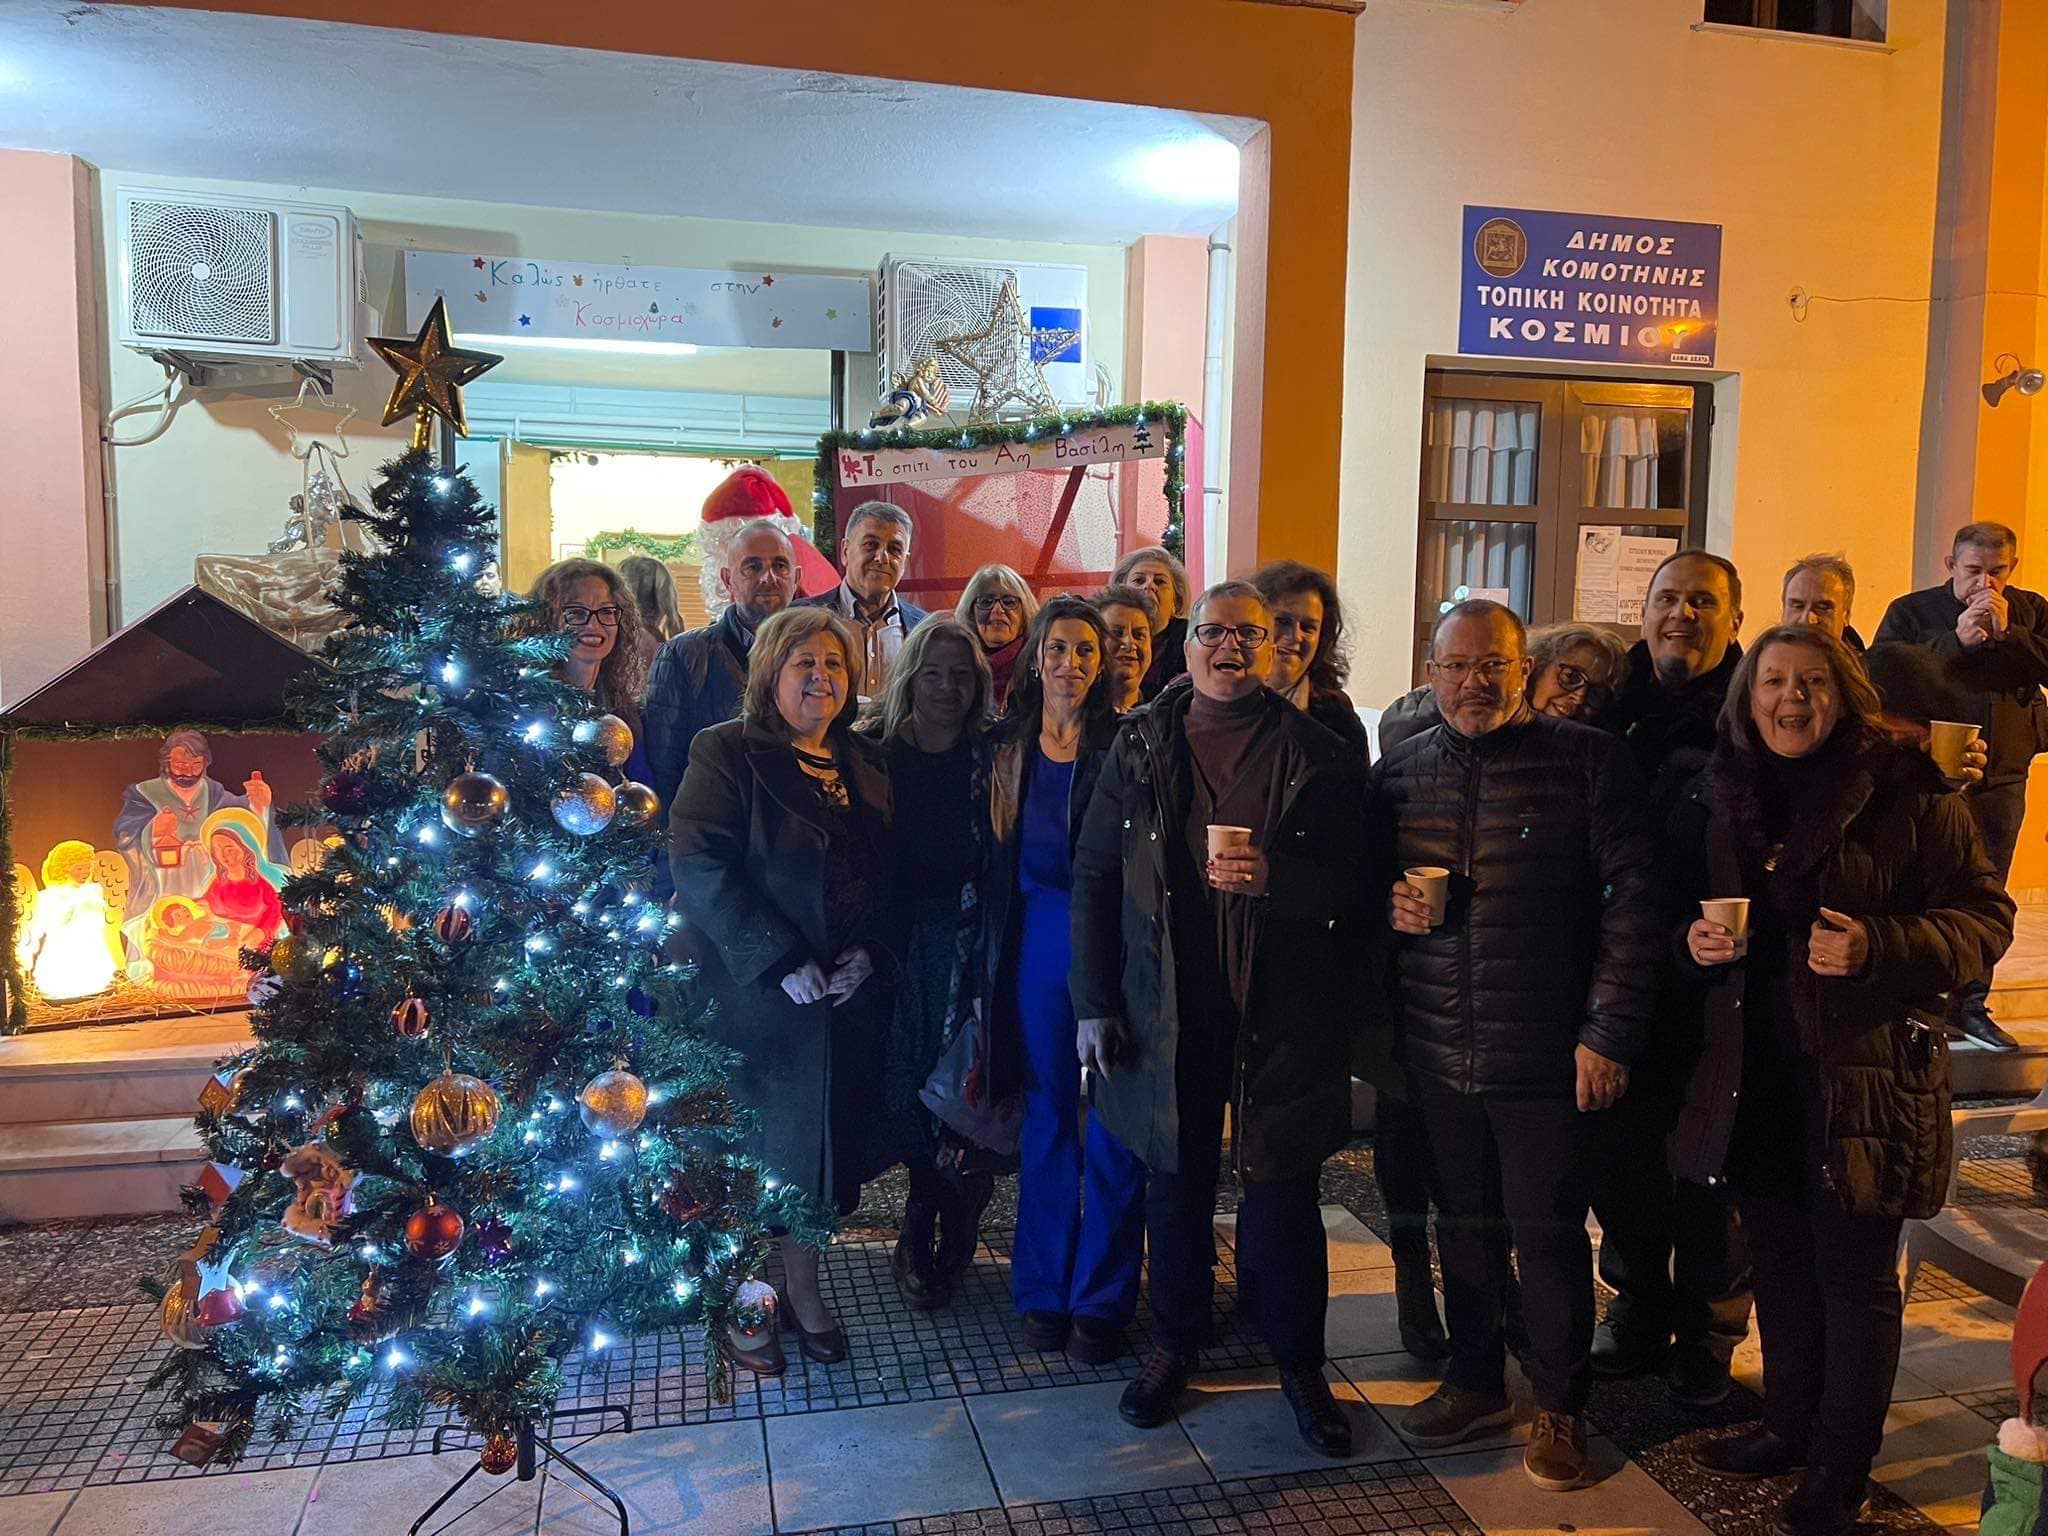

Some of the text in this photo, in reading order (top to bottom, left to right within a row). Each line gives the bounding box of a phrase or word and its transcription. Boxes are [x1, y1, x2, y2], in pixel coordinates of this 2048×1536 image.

[1567, 231, 1675, 255] ΔΗΜΟΣ
[710, 281, 760, 295] στην
[1543, 259, 1705, 287] ΚΟΜΟΤΗΝΗΣ
[1477, 285, 1702, 318] ΤΟΠΙΚΗ ΚΟΙΝΟΤΗΤΑ
[1489, 317, 1688, 349] ΚΟΣΜΙΟΥ
[862, 455, 883, 477] Το
[948, 459, 978, 470] του
[995, 444, 1031, 468] Αη
